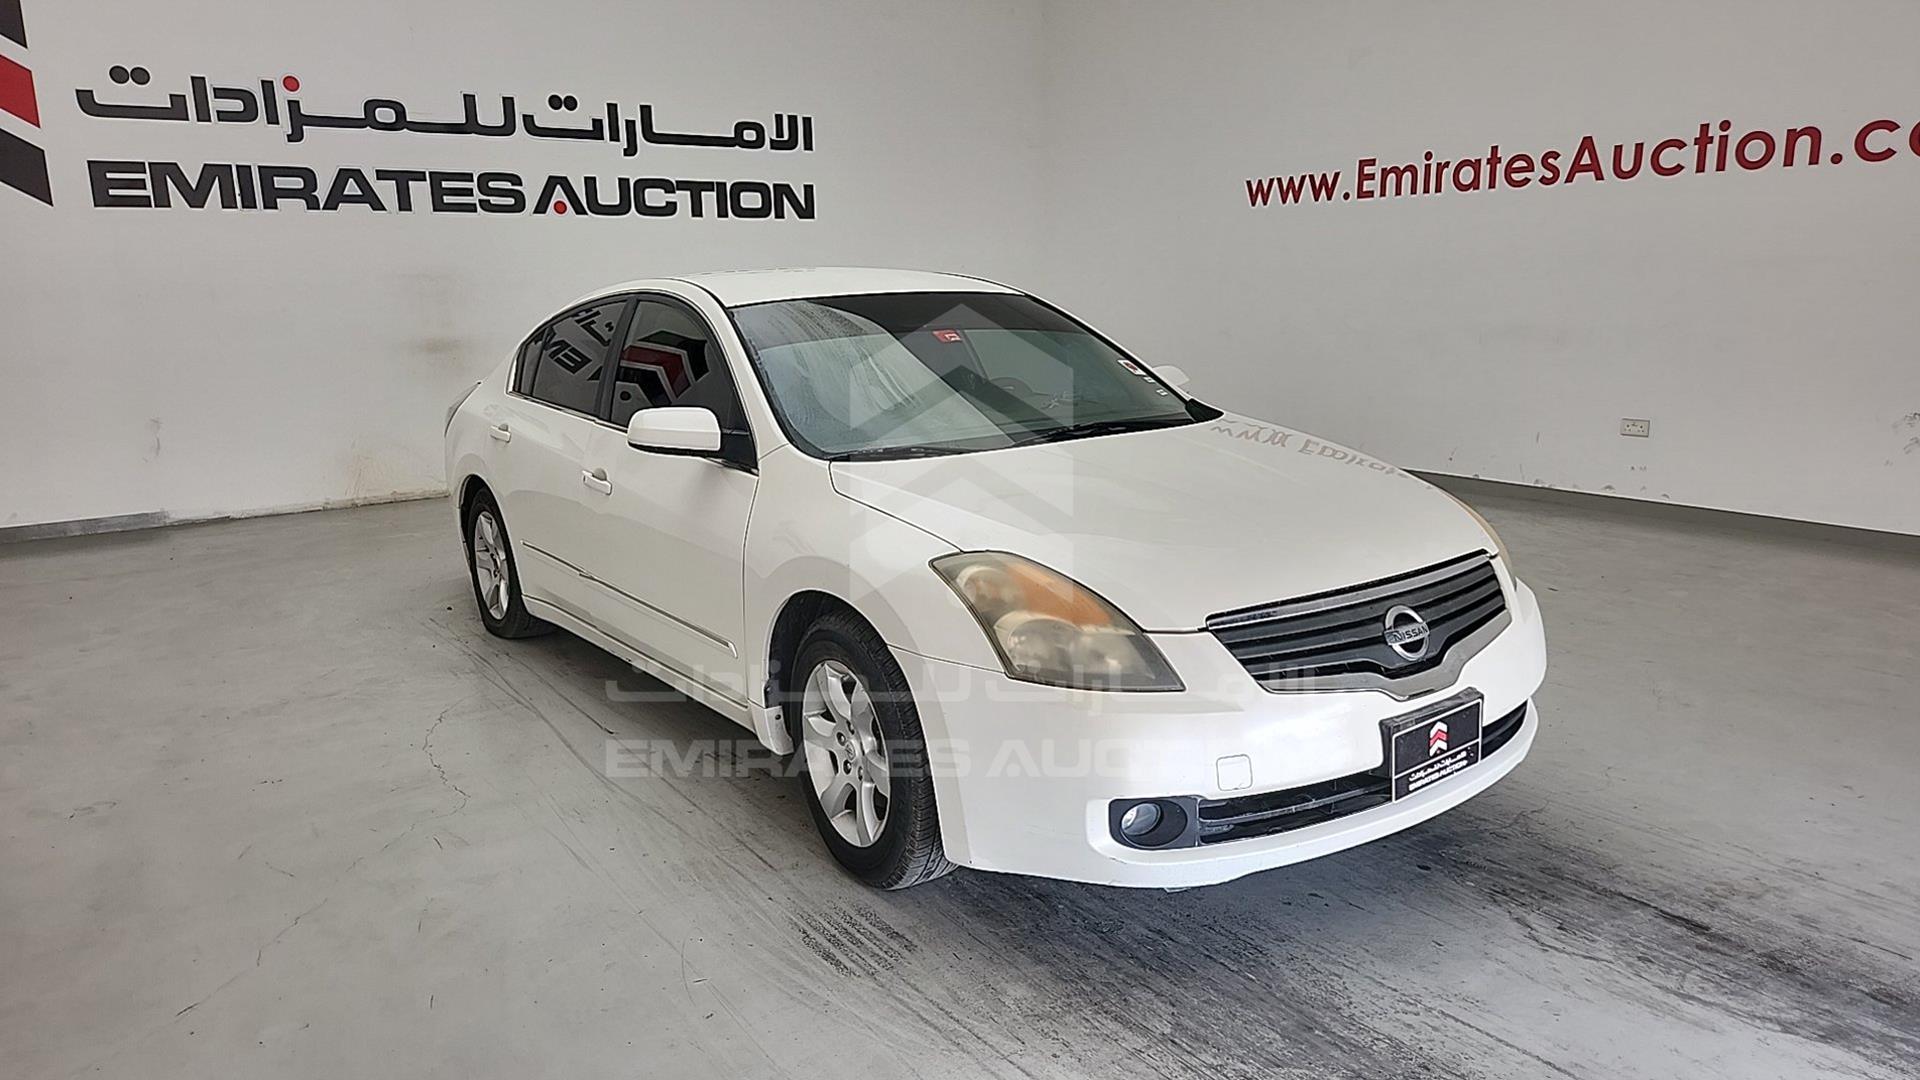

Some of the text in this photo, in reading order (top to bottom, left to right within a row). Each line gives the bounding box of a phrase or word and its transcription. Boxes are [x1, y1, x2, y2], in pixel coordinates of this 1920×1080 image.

[75, 64, 815, 158] الامارات للمزادات
[86, 158, 817, 221] EMIRATES AUCTION
[1245, 117, 1920, 207] www.EmiratesAuction.c
[1393, 624, 1428, 642] NISSAN
